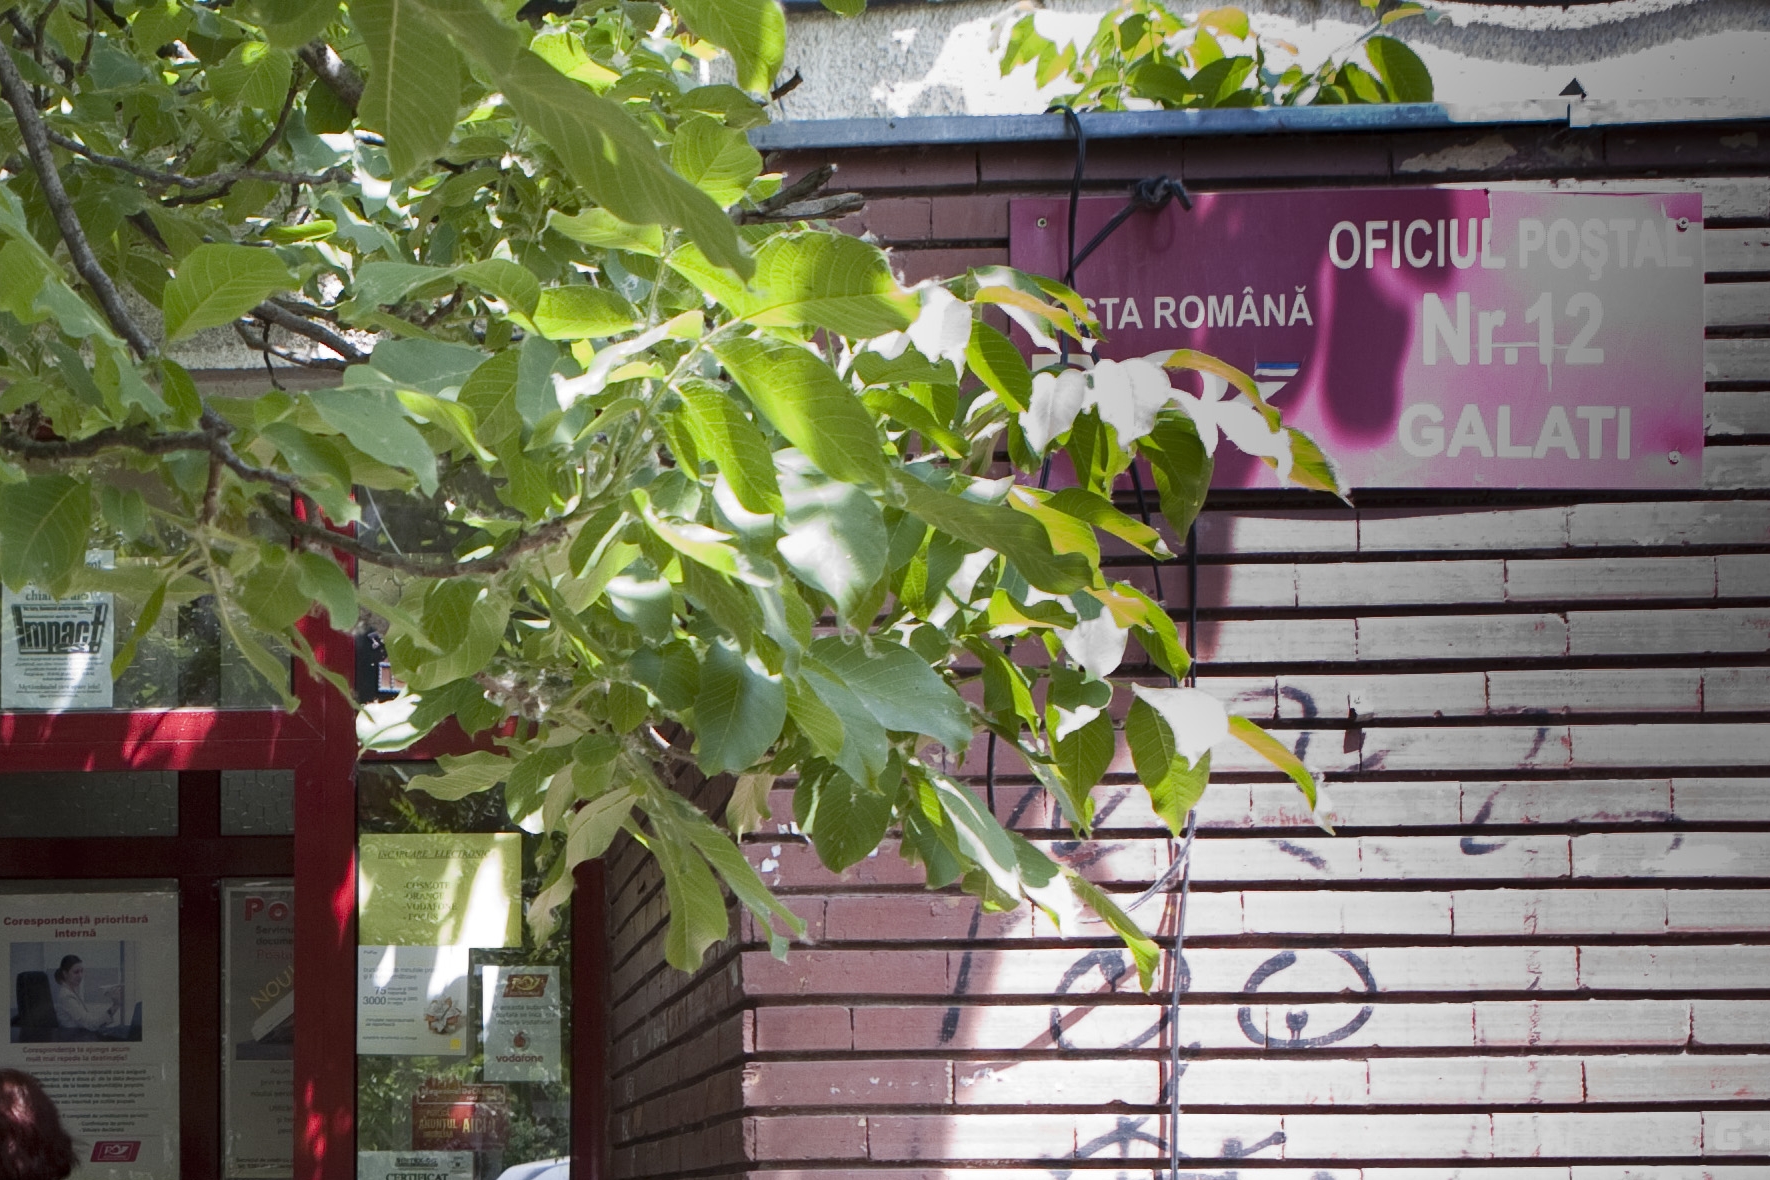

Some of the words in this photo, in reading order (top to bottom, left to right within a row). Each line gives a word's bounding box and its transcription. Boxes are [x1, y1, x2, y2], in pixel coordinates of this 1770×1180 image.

[1328, 217, 1507, 270] OFICIUL
[1517, 217, 1694, 281] POŞTAL
[1154, 285, 1313, 329] ROMÂNĂ
[1422, 292, 1604, 366] Nr.12
[1399, 406, 1632, 461] GALATI
[434, 850, 494, 859] ELECTRONIC
[3, 915, 91, 928] Corespondență
[94, 914, 149, 927] prioritară
[55, 927, 97, 939] internă
[363, 996, 387, 1006] 3000
[495, 1054, 544, 1063] vodafone
